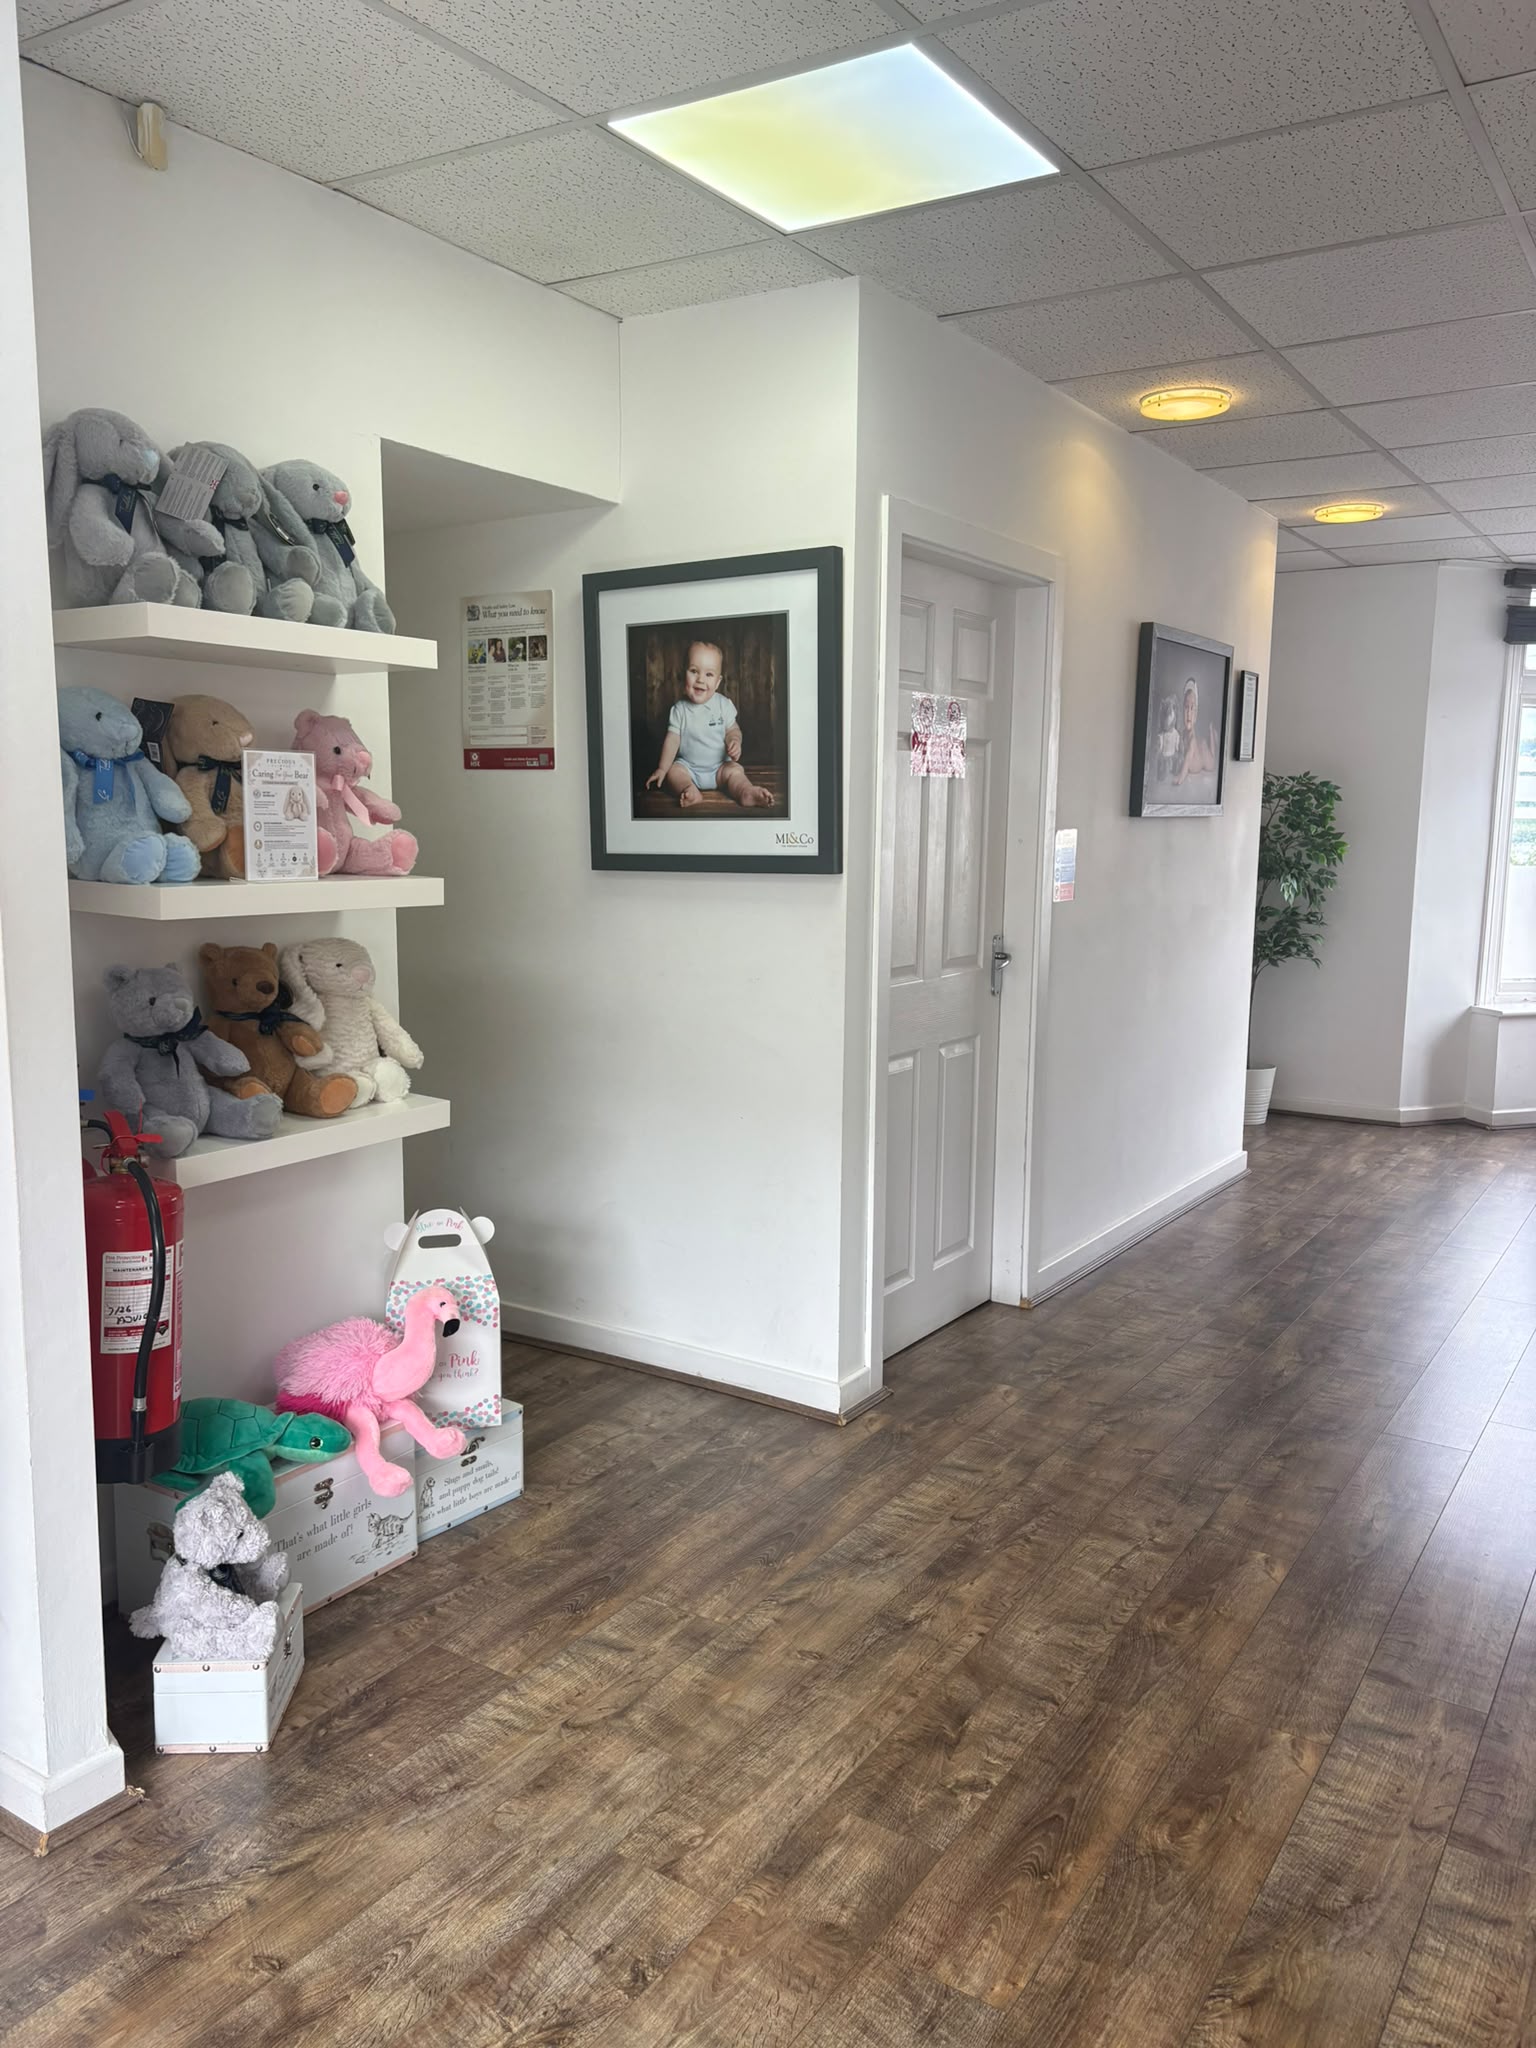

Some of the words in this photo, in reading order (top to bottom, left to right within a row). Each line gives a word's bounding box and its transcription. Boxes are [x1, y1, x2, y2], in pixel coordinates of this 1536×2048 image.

[482, 610, 497, 619] What
[498, 611, 508, 620] you
[509, 608, 522, 617] need
[523, 608, 530, 616] to
[530, 606, 547, 615] know
[252, 769, 274, 780] Caring
[294, 770, 309, 779] Bear
[775, 832, 815, 844] MI&Co
[416, 1222, 432, 1233] Blue
[446, 1216, 464, 1231] Pink
[448, 1350, 480, 1368] Pink
[454, 1368, 480, 1379] think?
[444, 1474, 462, 1488] Slugs
[462, 1467, 474, 1479] and
[437, 1504, 452, 1516] what
[453, 1496, 468, 1507] little
[468, 1490, 483, 1502] boys
[484, 1486, 494, 1494] are
[495, 1478, 510, 1489] made
[439, 1488, 451, 1501] and
[452, 1482, 471, 1498] puppy
[472, 1475, 484, 1486] dog
[275, 1532, 304, 1552] That's
[306, 1521, 328, 1538] what
[330, 1508, 351, 1528] little
[353, 1498, 372, 1520] girls
[296, 1546, 312, 1562] are
[314, 1533, 338, 1553] made
[340, 1523, 354, 1540] of!
